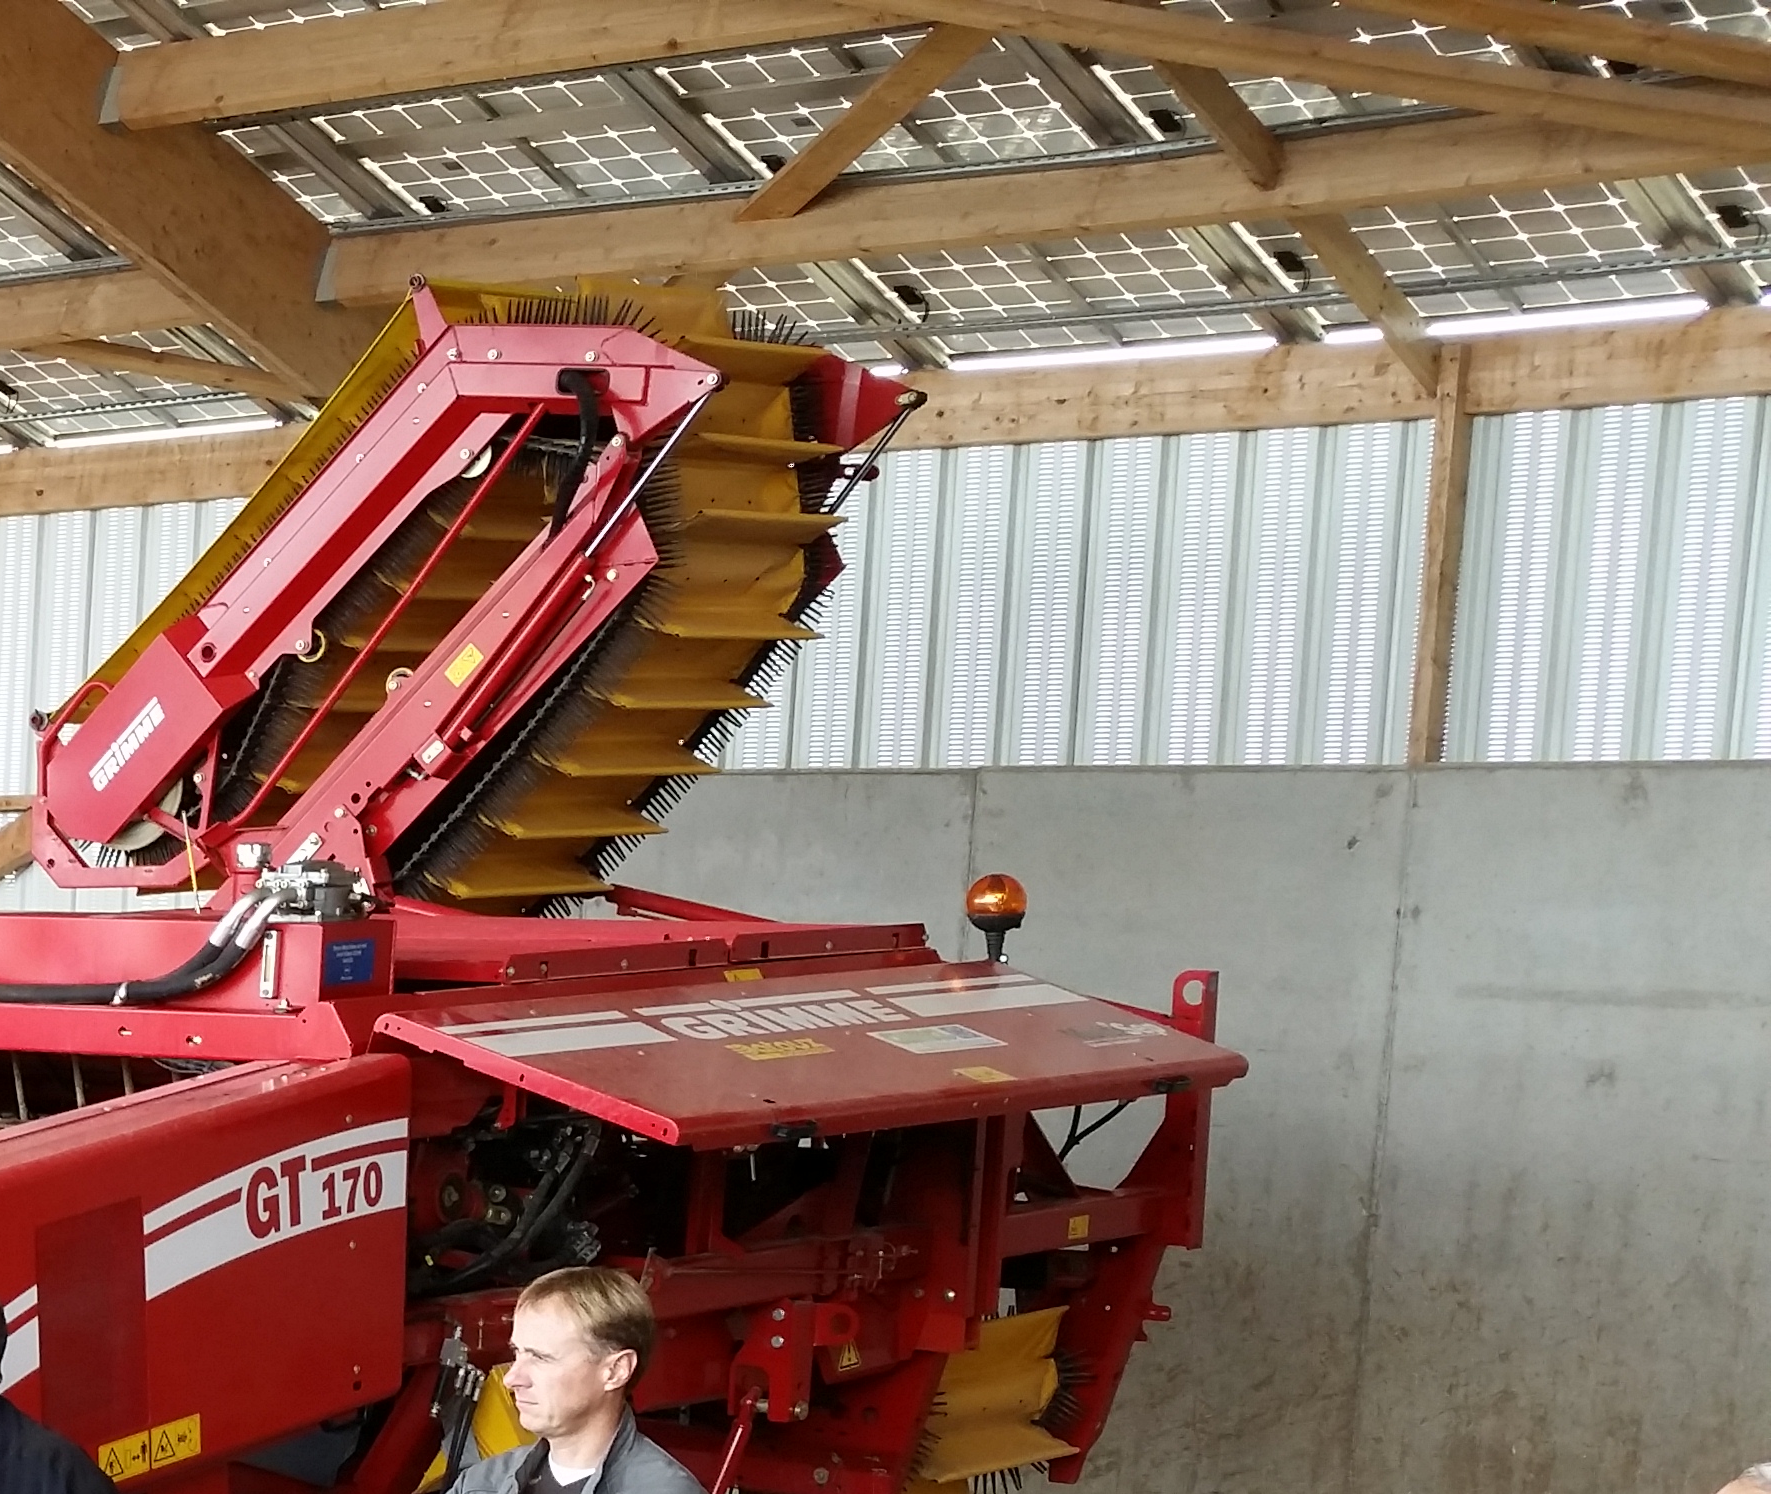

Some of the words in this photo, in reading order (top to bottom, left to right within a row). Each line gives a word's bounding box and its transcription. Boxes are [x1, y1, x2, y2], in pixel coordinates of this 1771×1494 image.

[89, 697, 165, 792] GRIMME
[661, 999, 911, 1040] GRIMME
[245, 1154, 307, 1240] GT
[321, 1161, 383, 1221] 170
